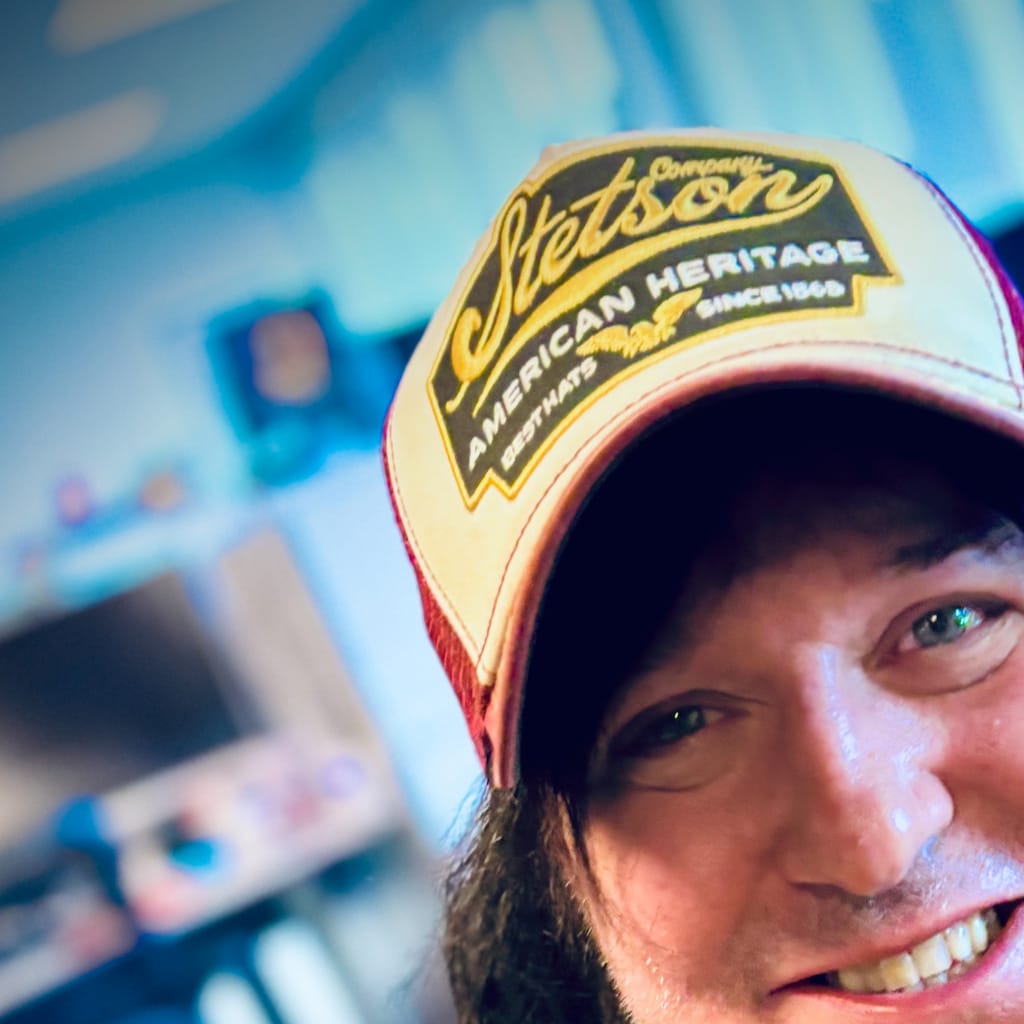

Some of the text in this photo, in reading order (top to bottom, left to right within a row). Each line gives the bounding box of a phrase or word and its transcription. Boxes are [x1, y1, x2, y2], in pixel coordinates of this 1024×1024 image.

[650, 155, 774, 180] Company
[445, 156, 833, 412] Stetson
[695, 284, 782, 320] SINCE
[467, 240, 870, 471] AMERICAN HERITAGE
